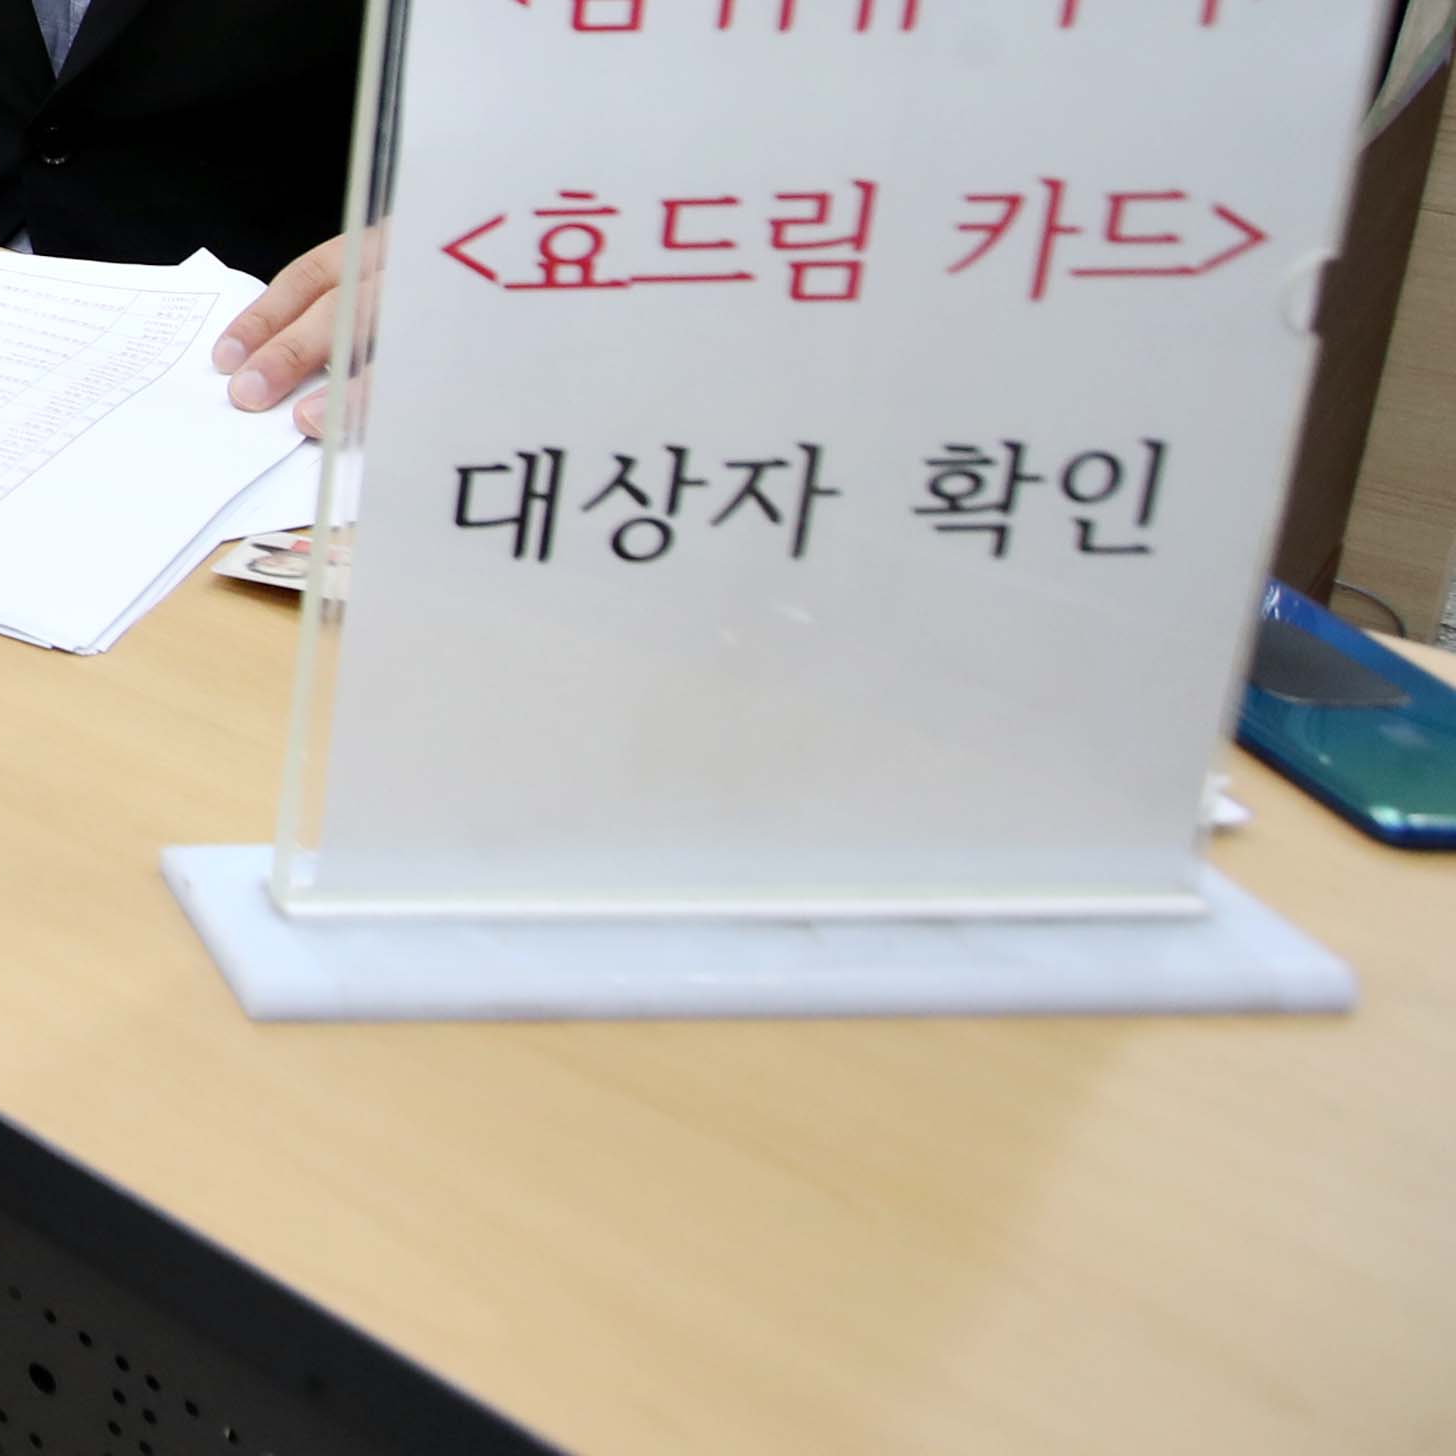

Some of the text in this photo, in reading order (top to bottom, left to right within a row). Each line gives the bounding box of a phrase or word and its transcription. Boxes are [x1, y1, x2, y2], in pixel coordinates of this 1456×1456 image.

[441, 178, 1269, 302] <효드림 카드>
[453, 440, 1171, 562] 대상자 확인
